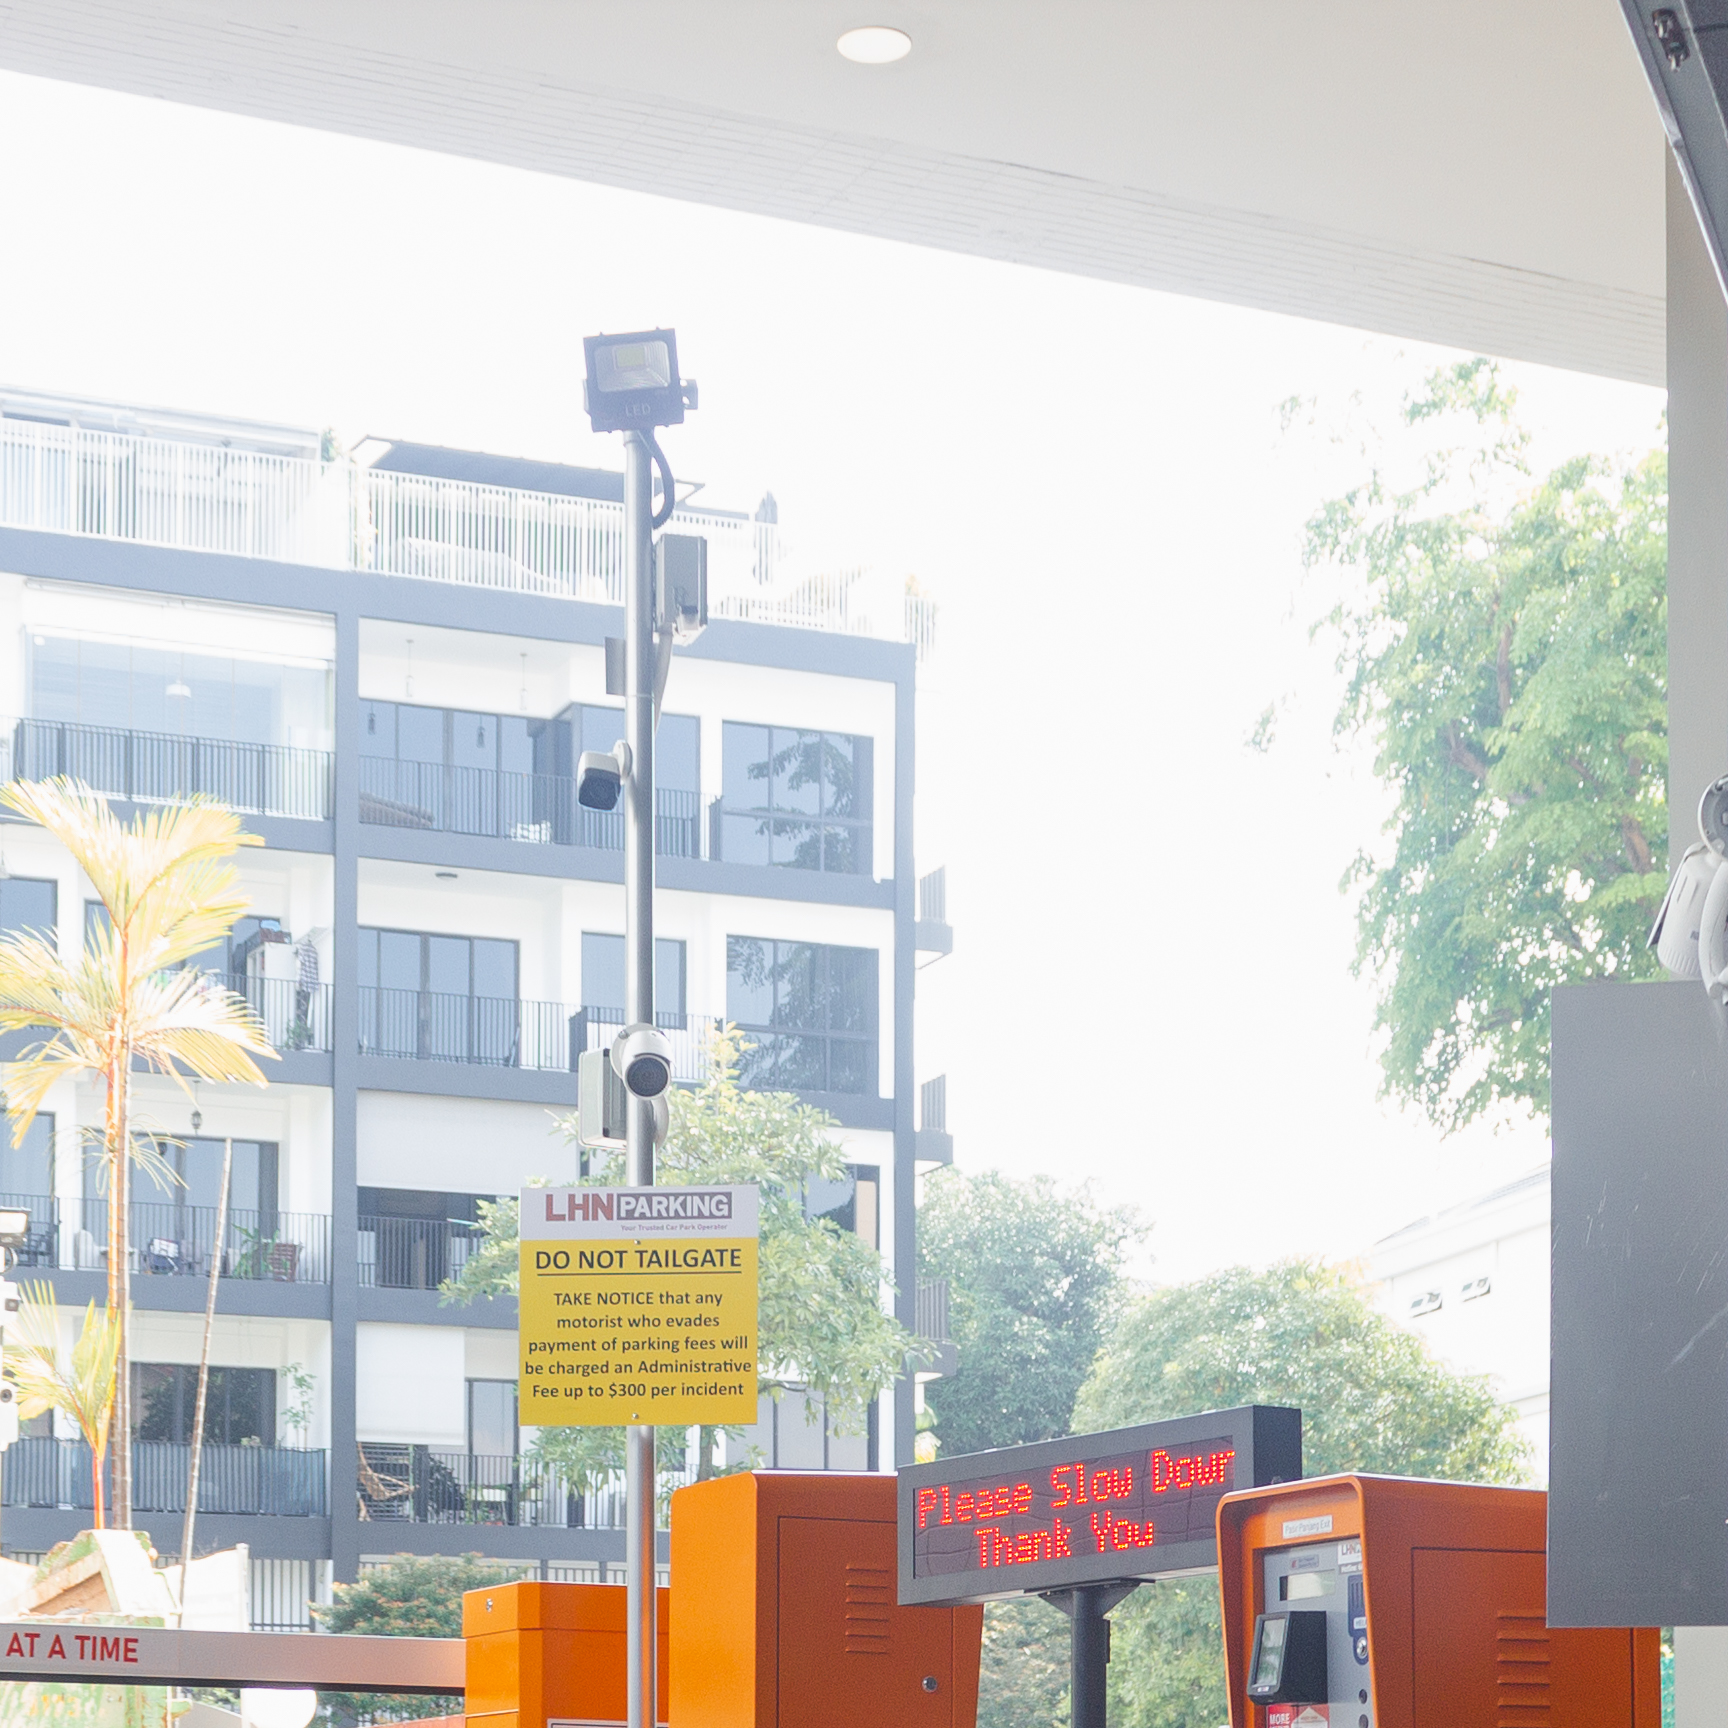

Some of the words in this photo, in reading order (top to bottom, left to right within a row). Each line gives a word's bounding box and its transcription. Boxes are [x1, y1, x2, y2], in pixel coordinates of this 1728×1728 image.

[545, 1193, 614, 1221] LHN
[619, 1195, 729, 1218] PARKING
[679, 1223, 696, 1231] Park
[697, 1223, 728, 1232] Operator
[536, 1250, 570, 1270] DO
[578, 1249, 629, 1270] NOT
[634, 1248, 742, 1269] TAILGATE
[554, 1292, 592, 1306] TAKE
[597, 1291, 655, 1306] NOTICE
[659, 1291, 691, 1305] that
[695, 1293, 723, 1307] any
[556, 1315, 623, 1329] motorist
[627, 1313, 662, 1328] who
[666, 1313, 720, 1327] evades
[528, 1339, 596, 1355] payment
[601, 1337, 617, 1352] of
[622, 1336, 680, 1353] parking
[684, 1336, 716, 1350] fees
[720, 1336, 748, 1349] will
[525, 1361, 544, 1375] be
[548, 1360, 609, 1377] charged
[614, 1363, 633, 1374] an
[638, 1359, 752, 1373] Administrative
[533, 1384, 560, 1398] Fee
[564, 1386, 583, 1400] up
[588, 1385, 604, 1397] to
[608, 1382, 646, 1399] $300
[651, 1385, 677, 1399] per
[681, 1382, 744, 1396] incident
[918, 1483, 1034, 1529] Please
[1050, 1462, 1133, 1508] Slow
[975, 1518, 1071, 1569] Thank
[1090, 1510, 1154, 1553] You
[5, 1632, 41, 1659] AT
[46, 1634, 68, 1660] A
[74, 1634, 140, 1664] TIME
